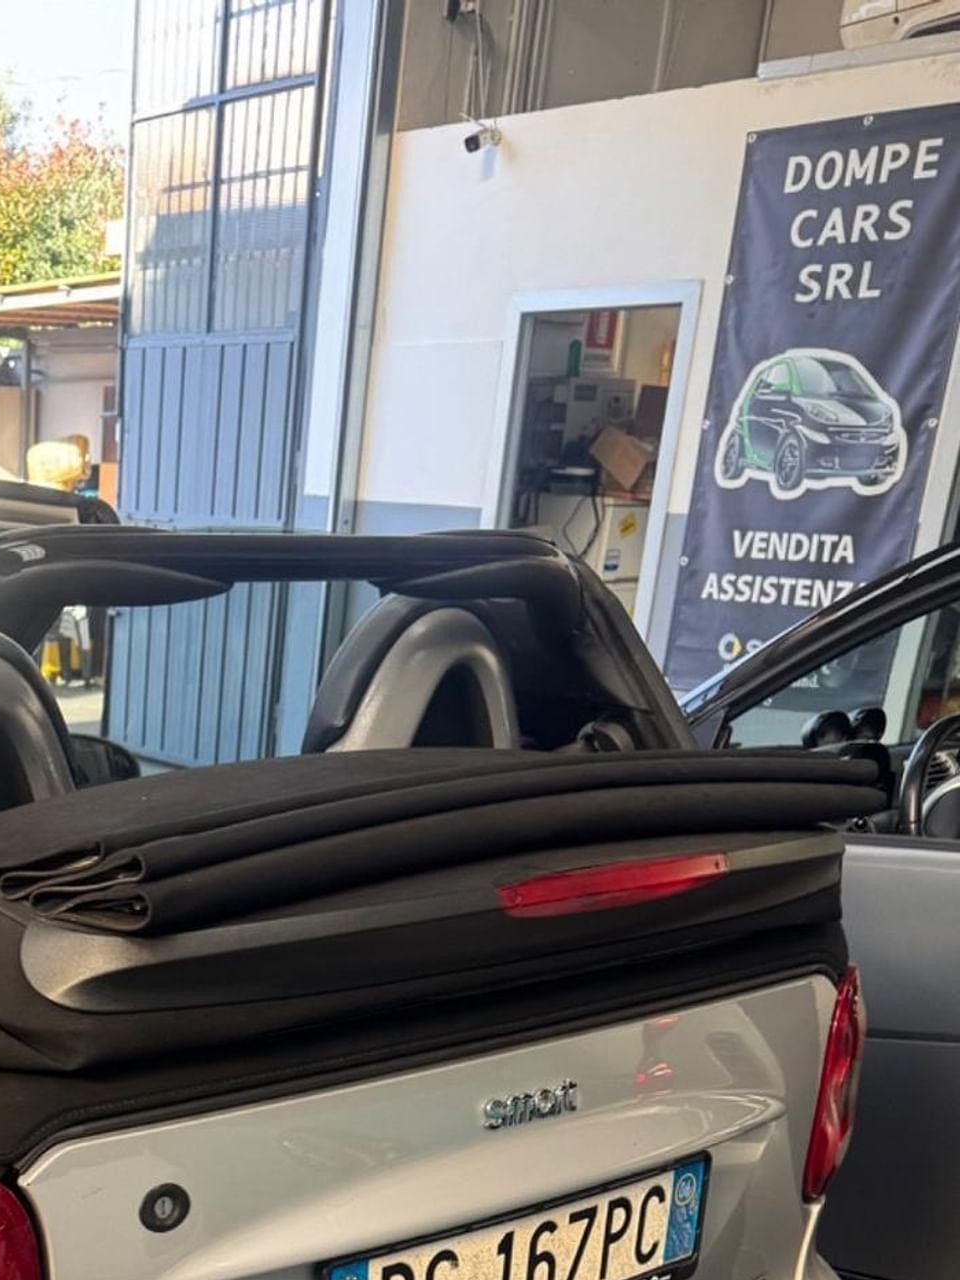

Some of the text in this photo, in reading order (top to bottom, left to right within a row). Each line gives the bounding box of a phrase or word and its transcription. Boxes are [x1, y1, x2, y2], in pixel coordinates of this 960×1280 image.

[784, 138, 943, 194] DOMPE
[790, 200, 913, 248] CARS
[796, 262, 881, 303] SRL
[732, 531, 854, 565] VENDITA
[701, 571, 866, 608] ASSISTENZ
[482, 1079, 578, 1129] smart
